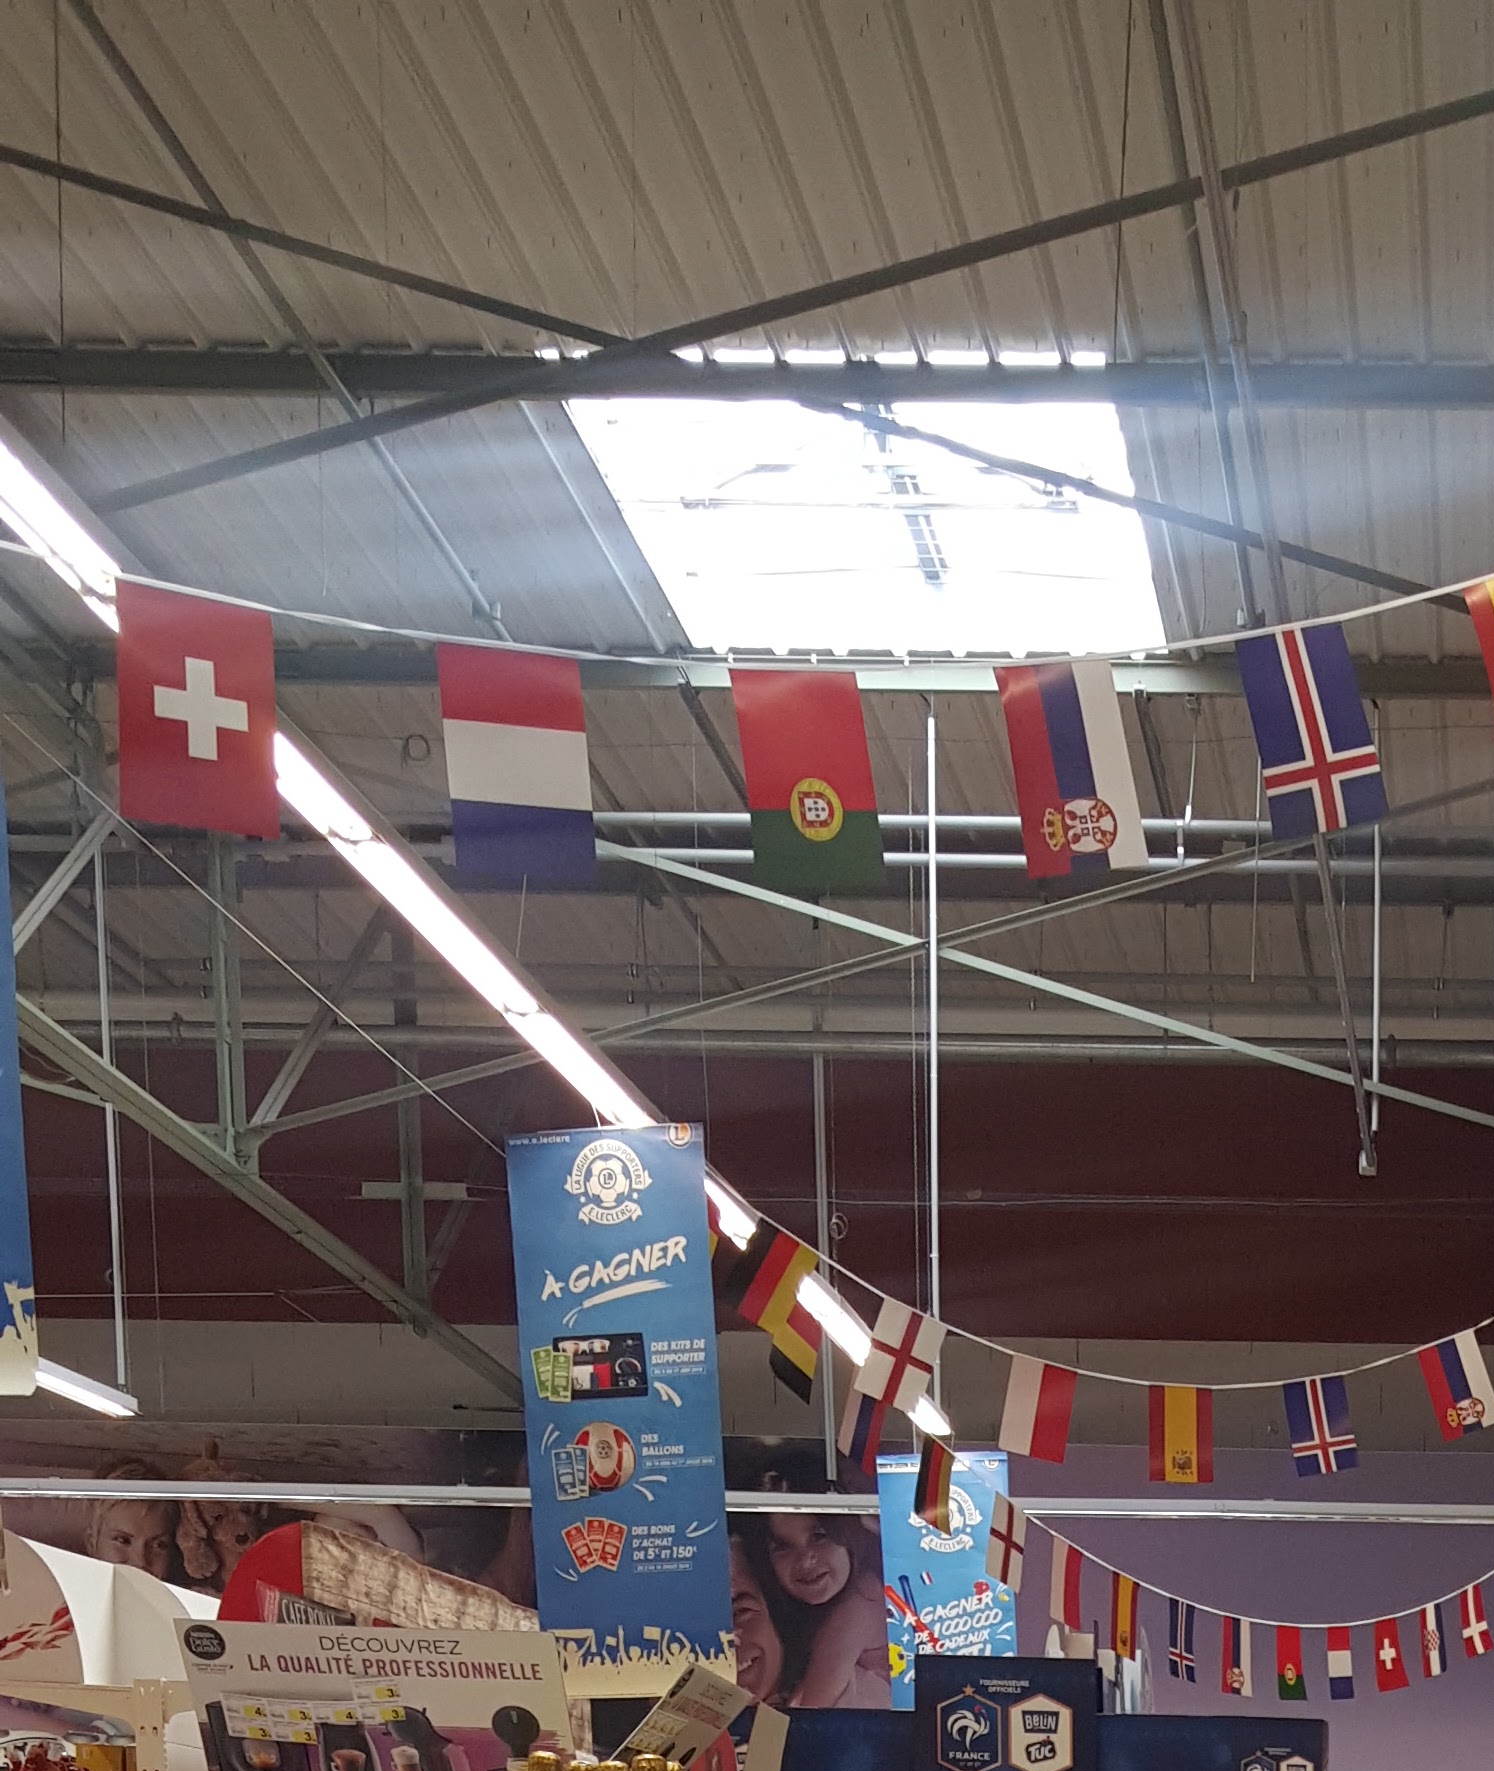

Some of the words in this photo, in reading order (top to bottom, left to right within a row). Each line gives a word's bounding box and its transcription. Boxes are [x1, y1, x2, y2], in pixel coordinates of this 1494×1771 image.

[540, 1269, 566, 1302] À
[568, 1235, 688, 1295] GAGNER
[651, 1352, 706, 1364] SUPPORTER
[641, 1434, 659, 1443] DES
[642, 1445, 685, 1456] BALLONS
[632, 1525, 649, 1535] DES
[919, 1592, 994, 1624] GAGNER
[319, 1632, 463, 1656] DÉCOUVREZ
[247, 1653, 272, 1671] LA
[276, 1654, 358, 1675] QUALITÉ
[363, 1658, 543, 1681] PROFESSIONNELLE
[948, 1751, 991, 1761] FRANCE
